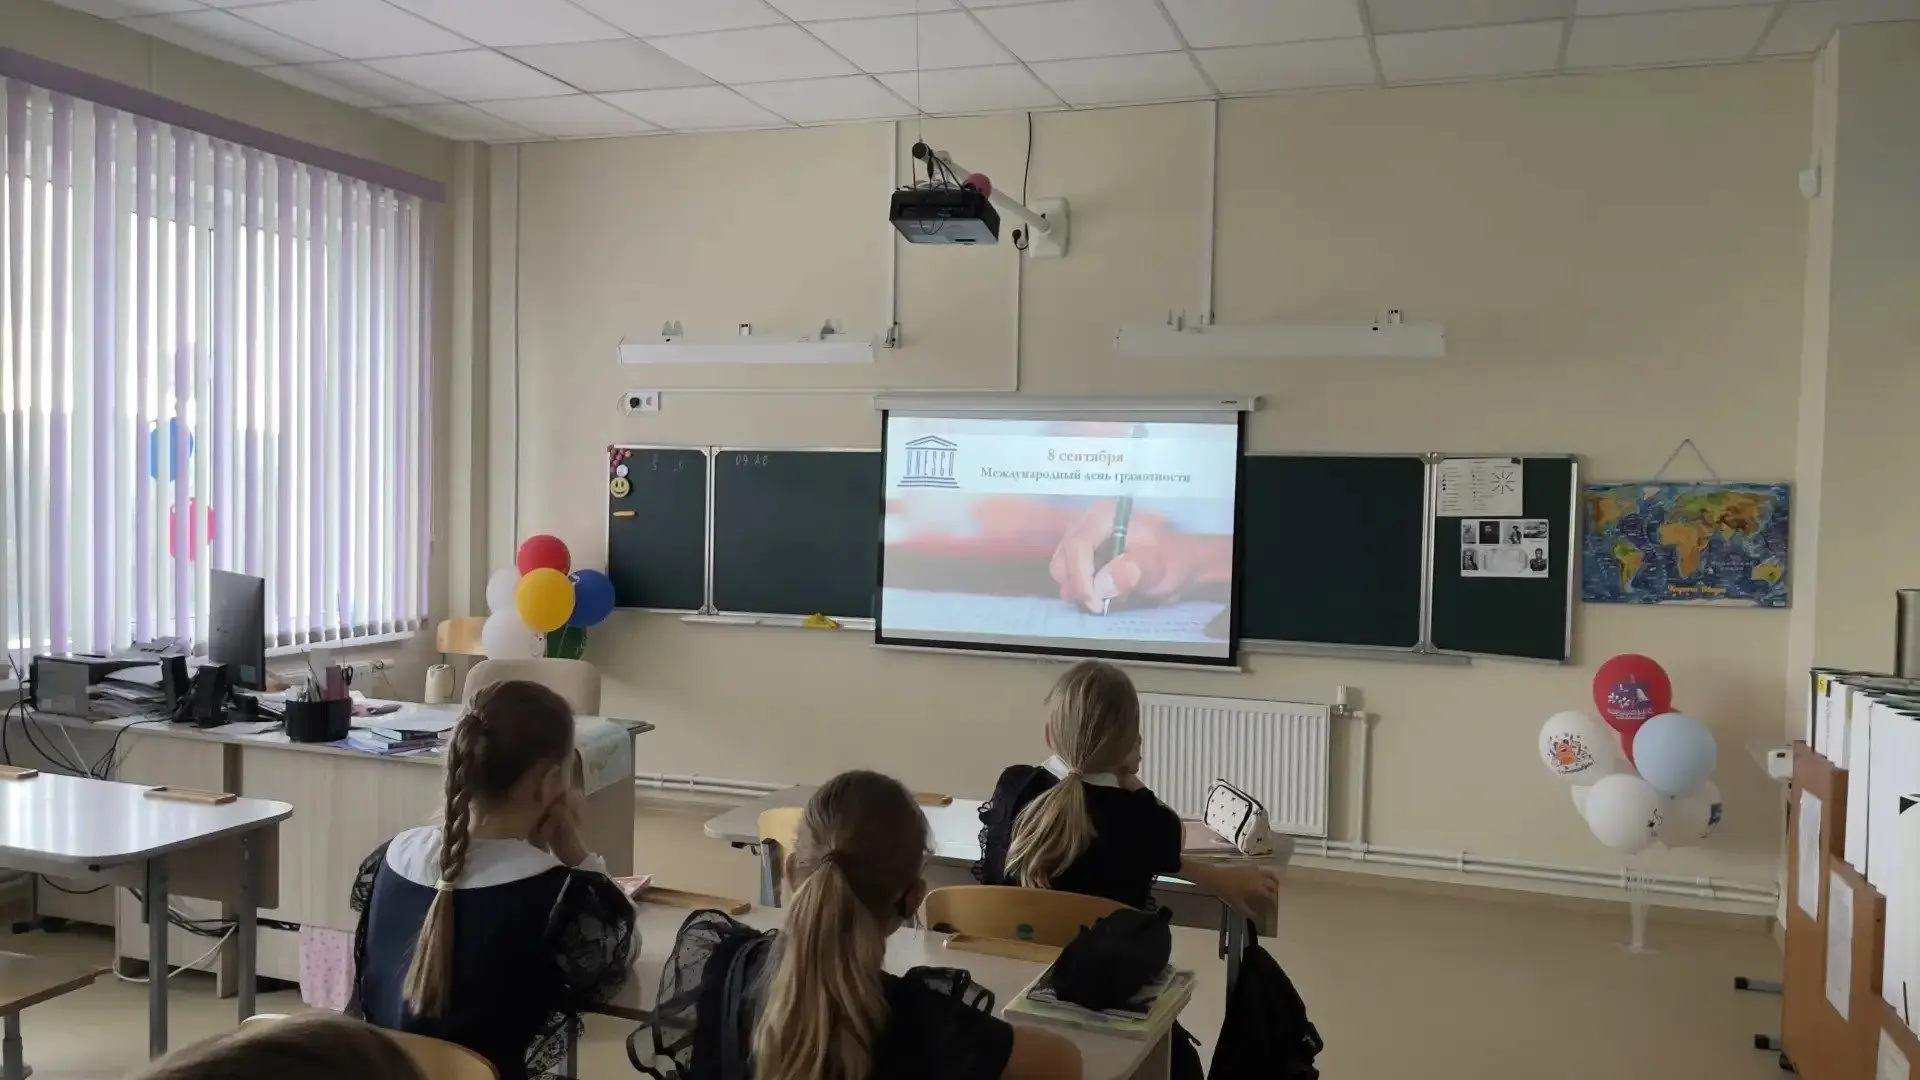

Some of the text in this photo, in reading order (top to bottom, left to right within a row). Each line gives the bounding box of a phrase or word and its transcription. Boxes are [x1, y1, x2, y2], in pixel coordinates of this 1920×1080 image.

[906, 450, 955, 477] UNESCO
[1047, 448, 1124, 466] 8 сентября
[980, 466, 1191, 484] Международный день грамотности
